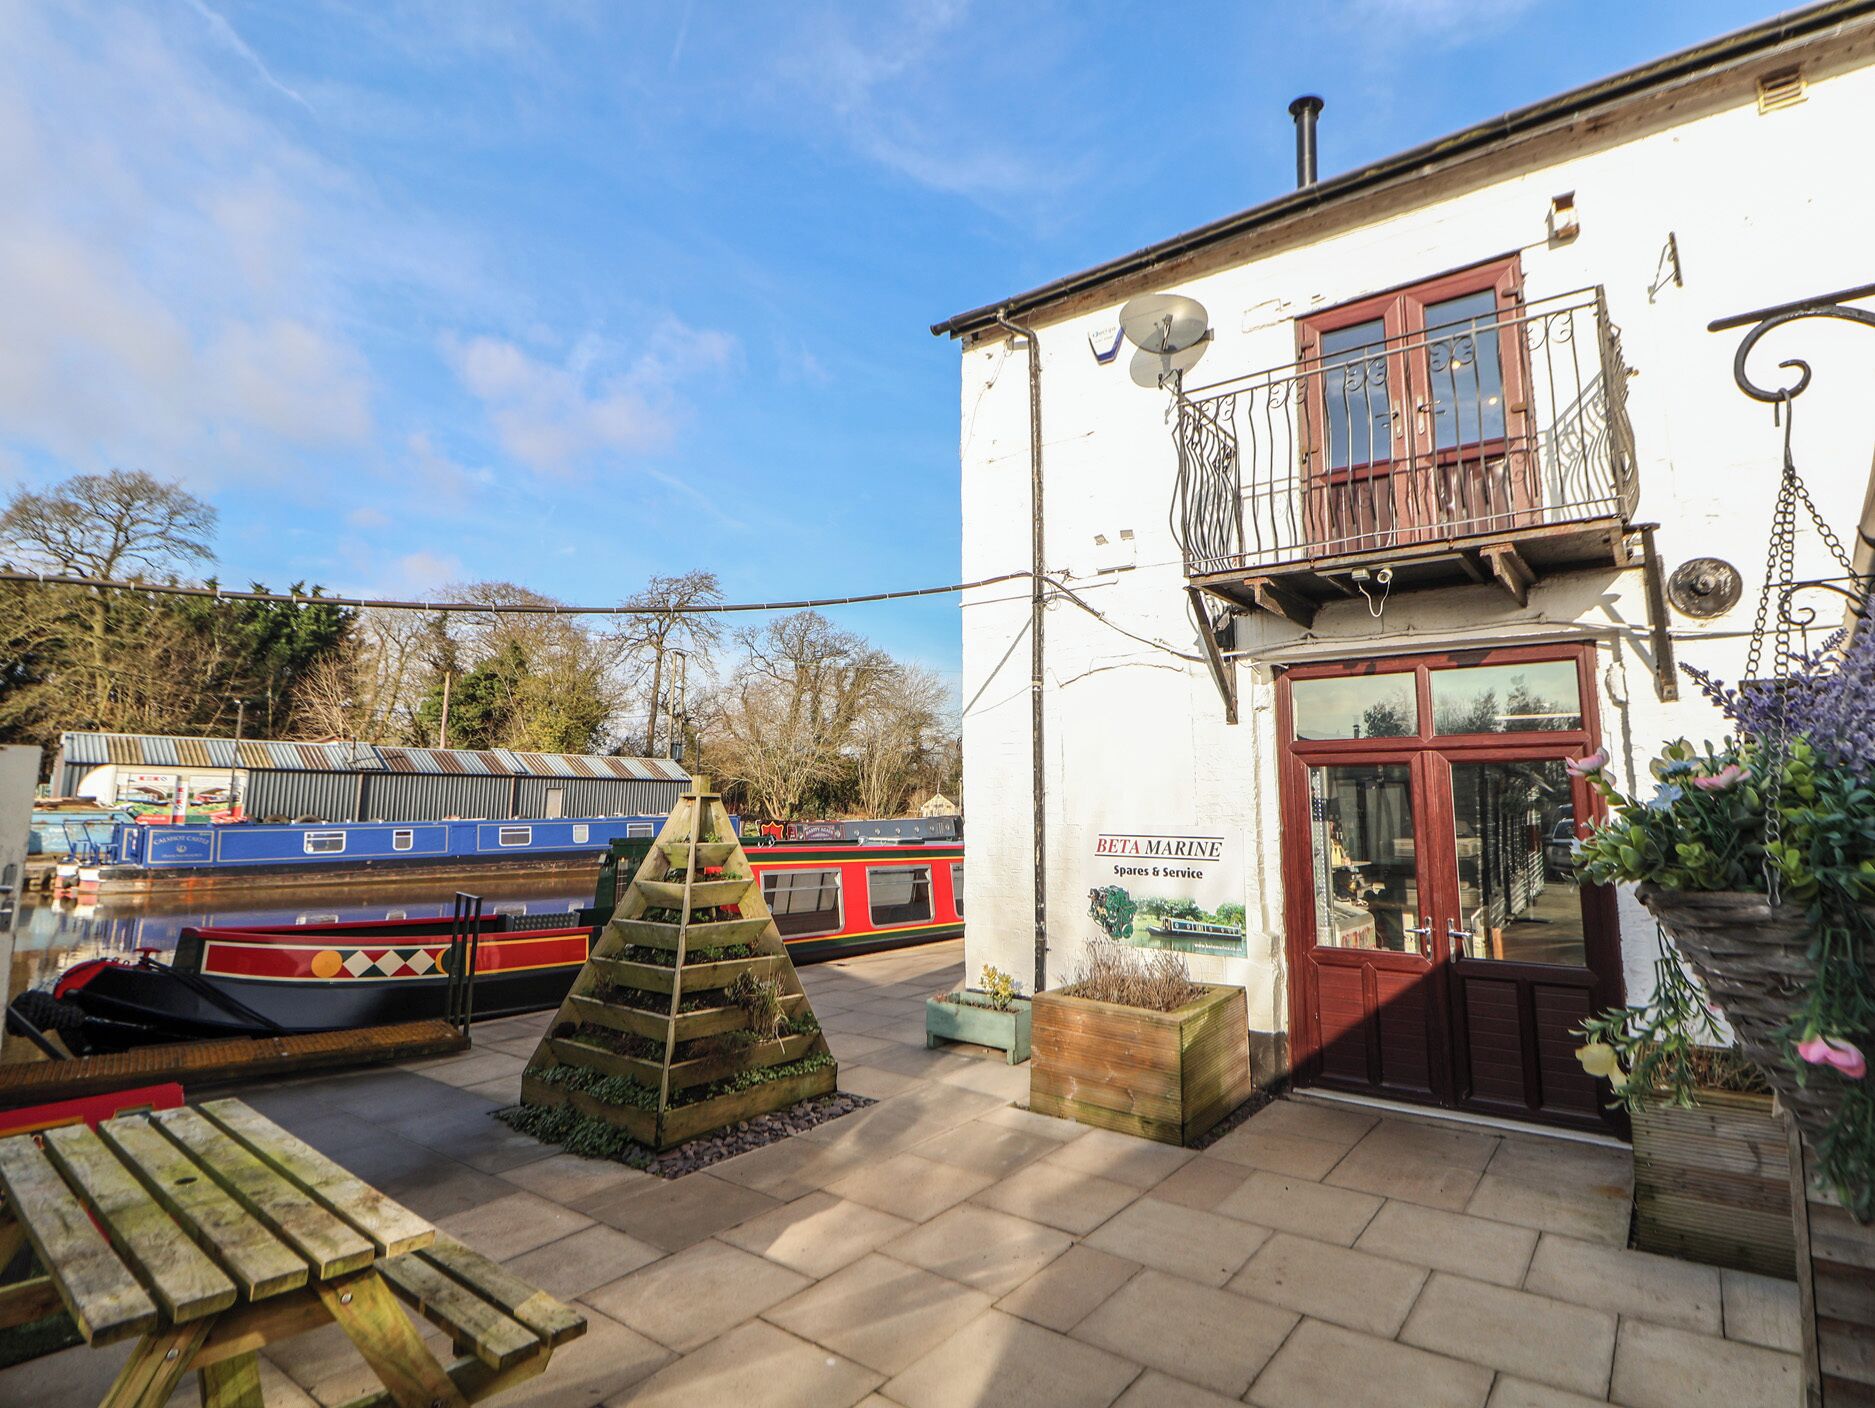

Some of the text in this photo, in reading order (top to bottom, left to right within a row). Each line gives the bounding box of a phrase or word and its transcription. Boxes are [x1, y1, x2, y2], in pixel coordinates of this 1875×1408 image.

[1096, 838, 1223, 857] BETA MARINE
[1114, 865, 1203, 879] Spares & Service
